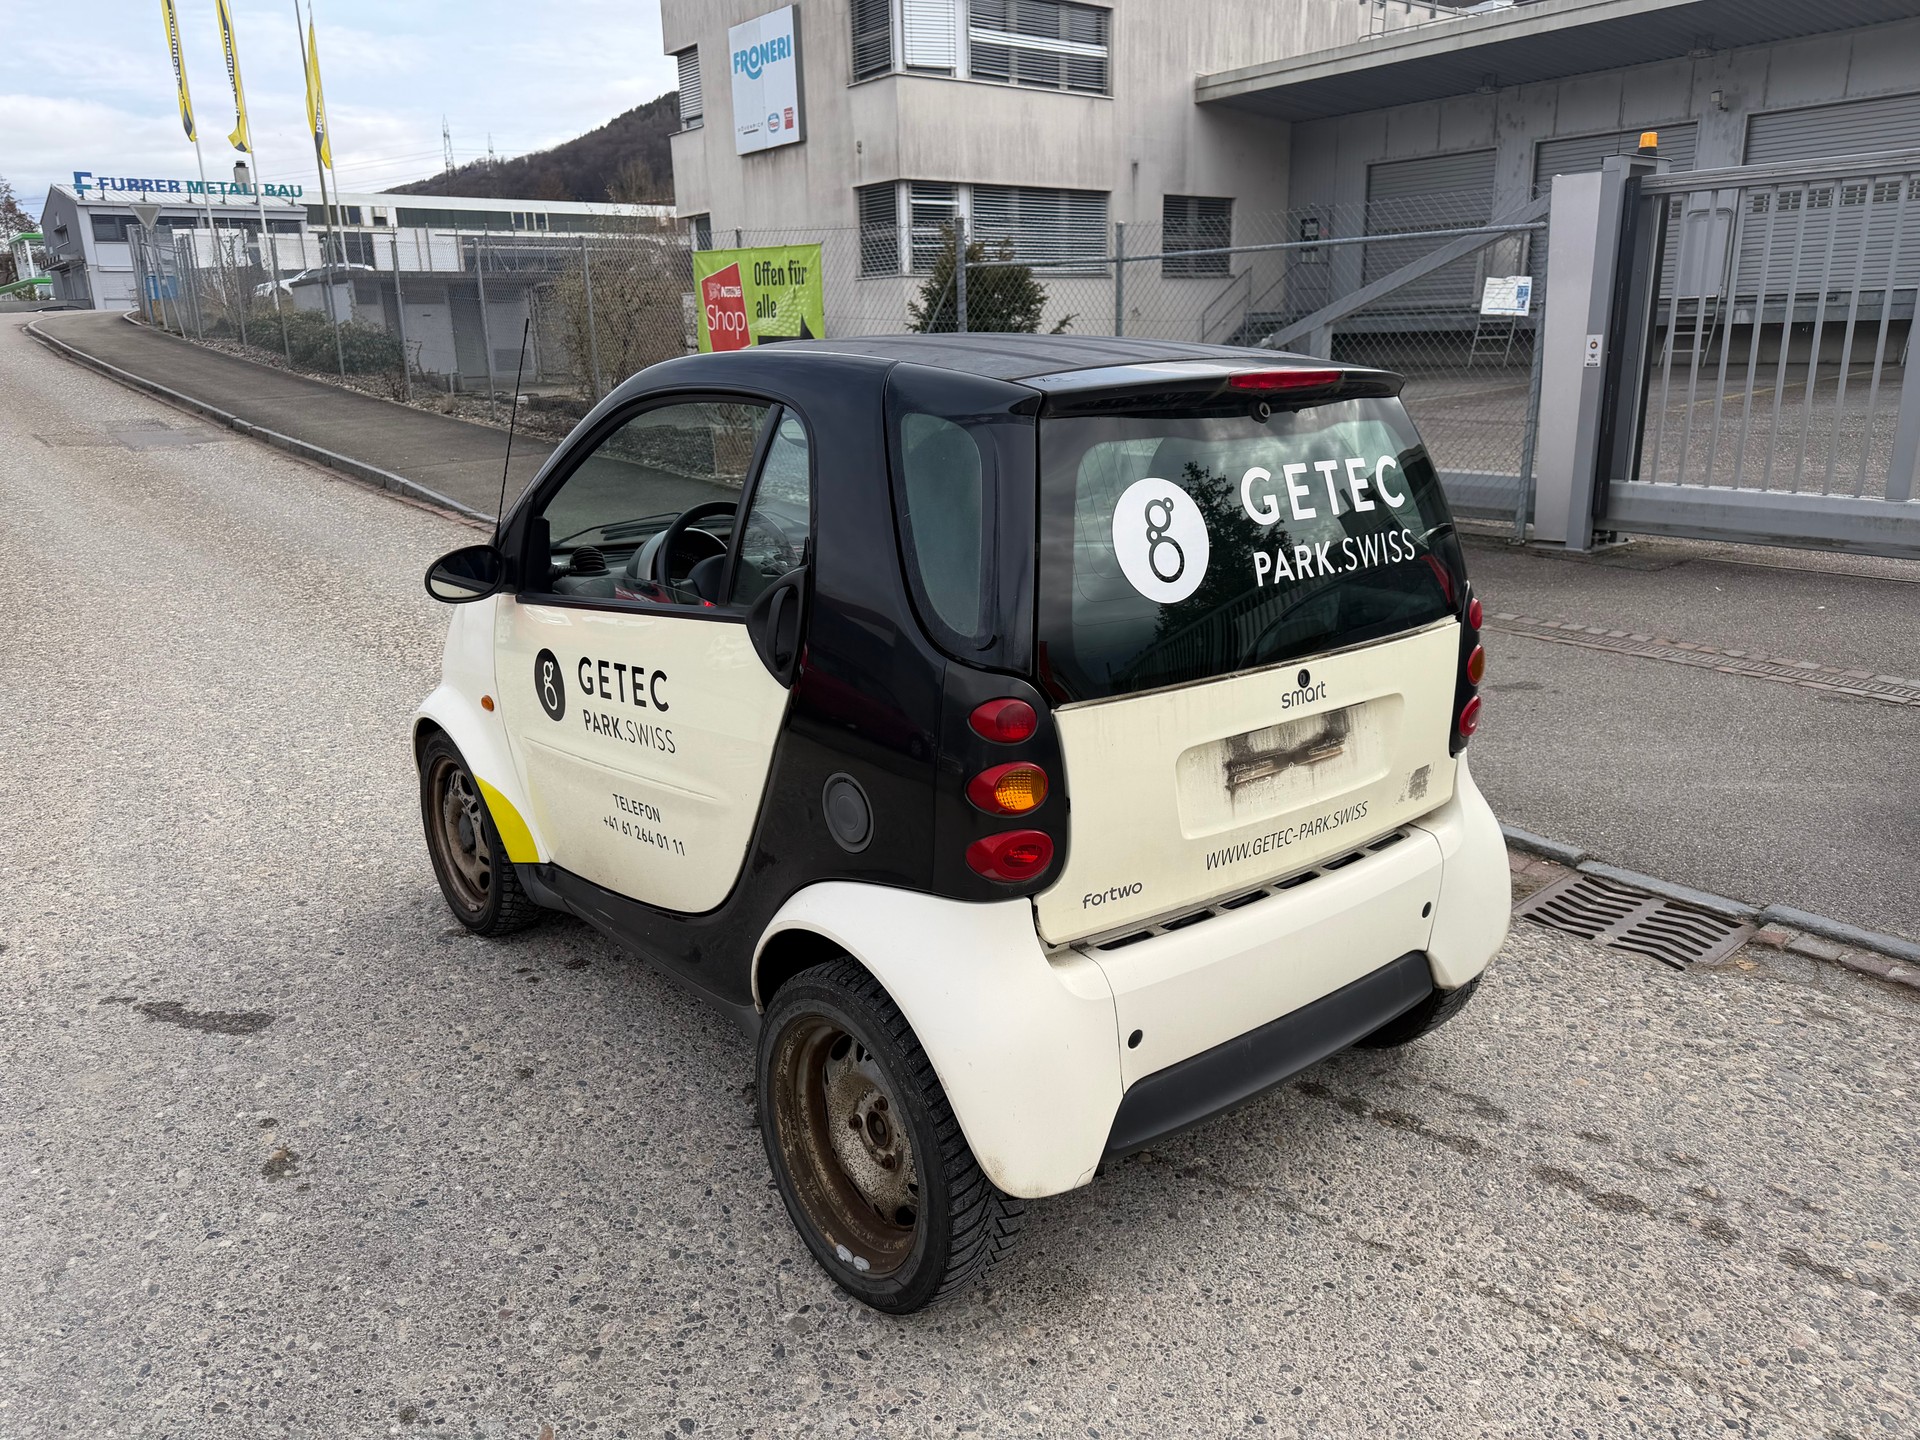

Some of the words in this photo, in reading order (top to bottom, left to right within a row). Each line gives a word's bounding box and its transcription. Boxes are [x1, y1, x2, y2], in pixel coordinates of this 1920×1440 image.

[733, 34, 791, 80] FRONERI
[98, 176, 181, 193] FURRER
[754, 261, 785, 286] Offen
[788, 259, 807, 285] für
[707, 304, 746, 340] Shop
[756, 294, 777, 318] alle
[1240, 455, 1405, 526] GETEC
[1254, 528, 1416, 587] PARK.SWISS
[577, 656, 670, 712] GETEC
[1281, 680, 1327, 709] smart
[583, 709, 676, 754] PARK.SWISS
[612, 793, 661, 823] TELEFON
[603, 815, 619, 831] +41
[621, 821, 633, 837] 61
[634, 825, 655, 845] 264
[656, 832, 669, 851] 01
[672, 838, 685, 857] 11
[1205, 801, 1368, 871] WWW.GETEC-PARK.SWISS
[1082, 881, 1143, 909] fortwo
